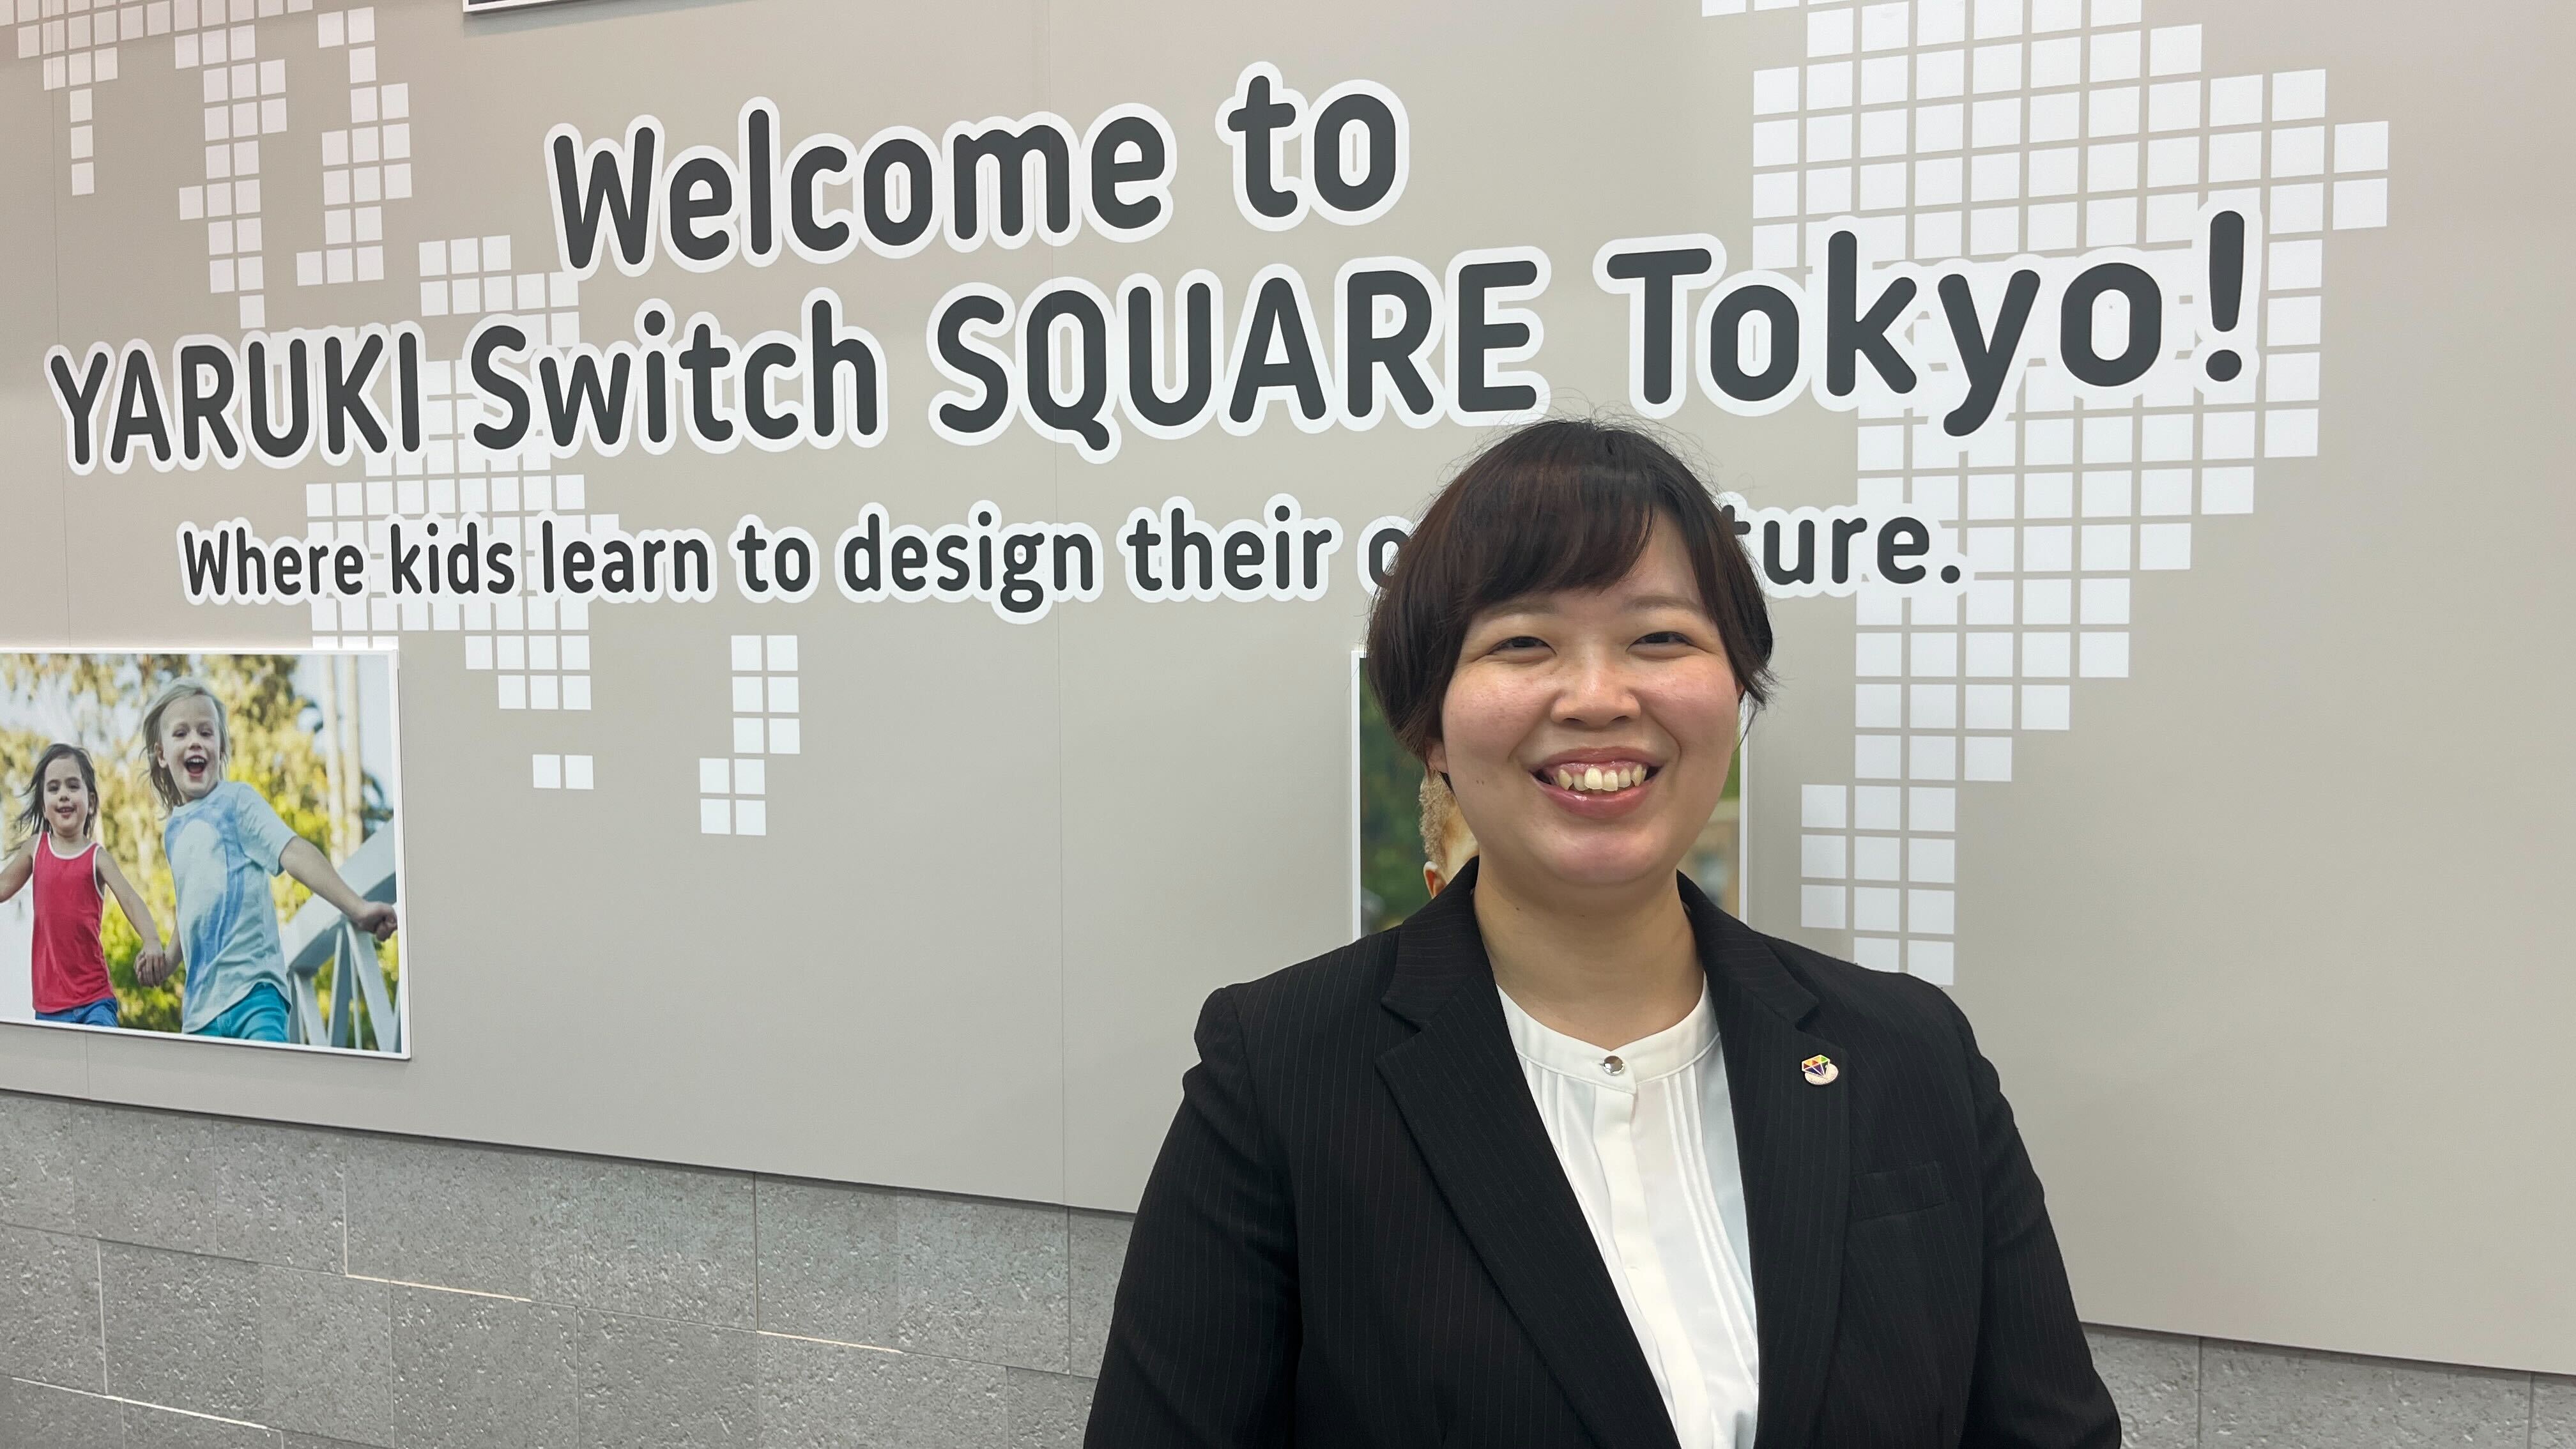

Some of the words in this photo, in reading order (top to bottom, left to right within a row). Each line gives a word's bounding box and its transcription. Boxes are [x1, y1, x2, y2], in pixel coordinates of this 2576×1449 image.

[553, 109, 1166, 269] Welcome
[1227, 75, 1396, 218] to
[50, 332, 420, 465] YARUKI
[471, 300, 877, 450] Switch
[937, 260, 1538, 451] SQUARE
[1607, 210, 2244, 437] Tokyo!
[183, 527, 364, 596] Where
[390, 522, 515, 594] kids
[542, 520, 709, 594] learn
[737, 525, 811, 592] to
[844, 510, 1093, 613] design
[1126, 505, 1332, 592] their
